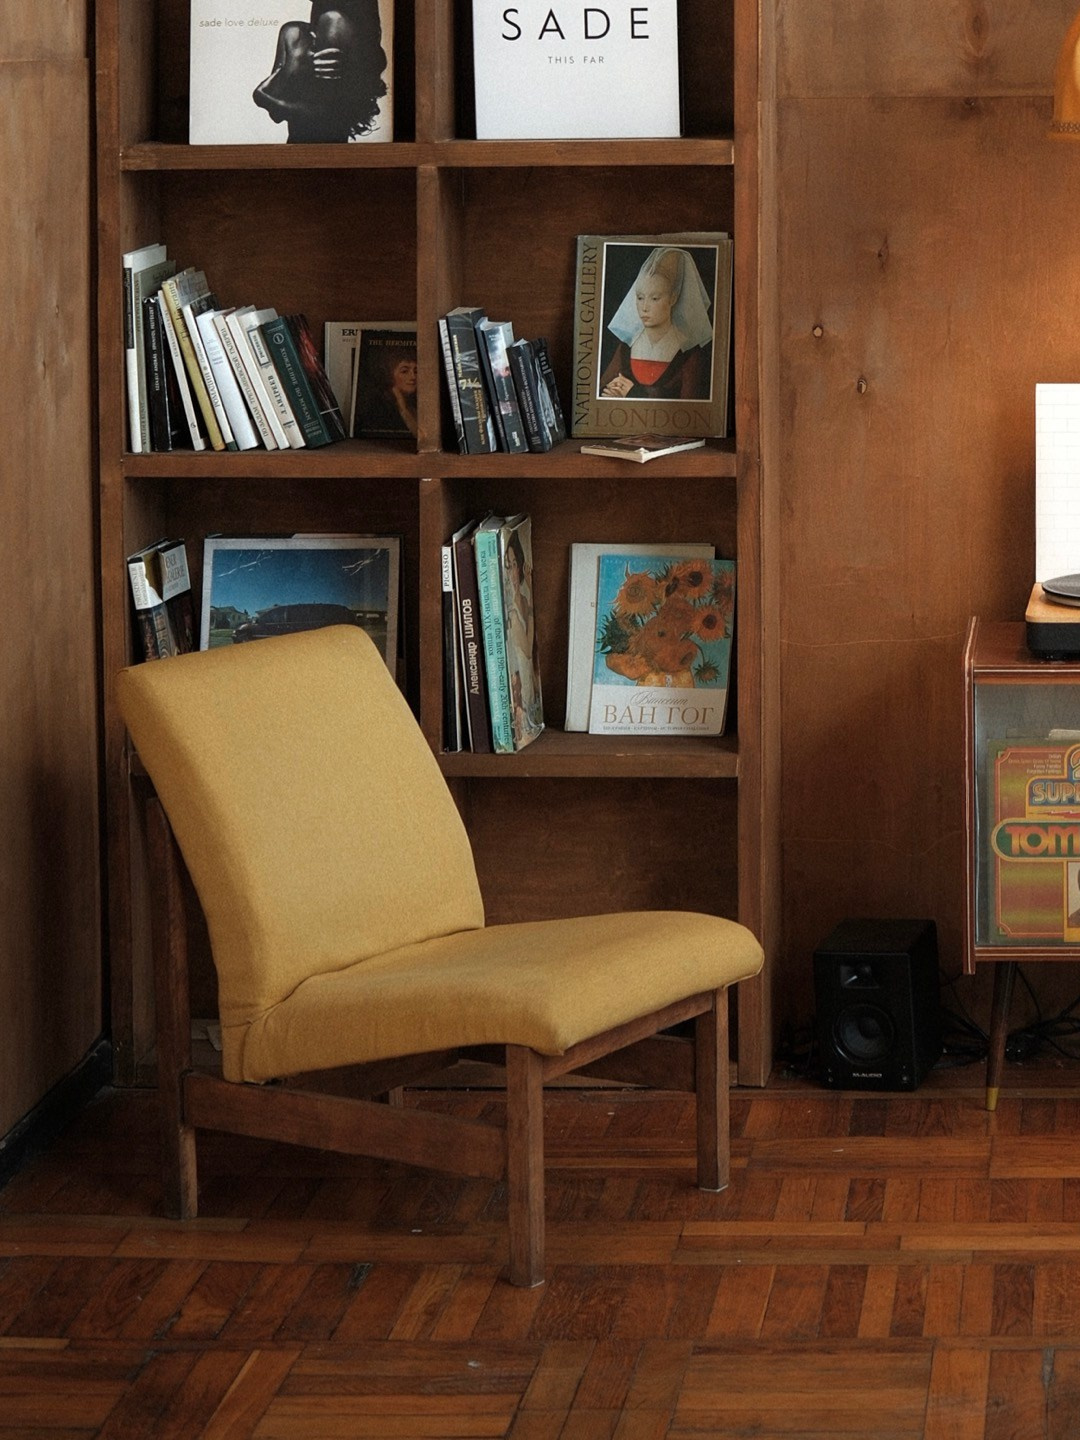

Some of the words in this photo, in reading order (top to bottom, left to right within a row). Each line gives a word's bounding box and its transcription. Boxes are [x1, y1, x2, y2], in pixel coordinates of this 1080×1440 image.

[199, 18, 222, 28] sade
[224, 18, 244, 27] love
[248, 18, 280, 27] deluxe
[502, 8, 650, 41] SADE
[548, 56, 575, 64] THIS
[584, 56, 605, 64] FAR
[580, 243, 598, 325] GALLERY
[574, 328, 593, 426] NATIONAL
[594, 409, 713, 431] LONDON
[462, 598, 475, 639] ШИЛОВ
[466, 641, 480, 695] Александр
[501, 711, 512, 745] centuries
[604, 704, 657, 724] ВАН
[668, 706, 714, 724] ГОГ
